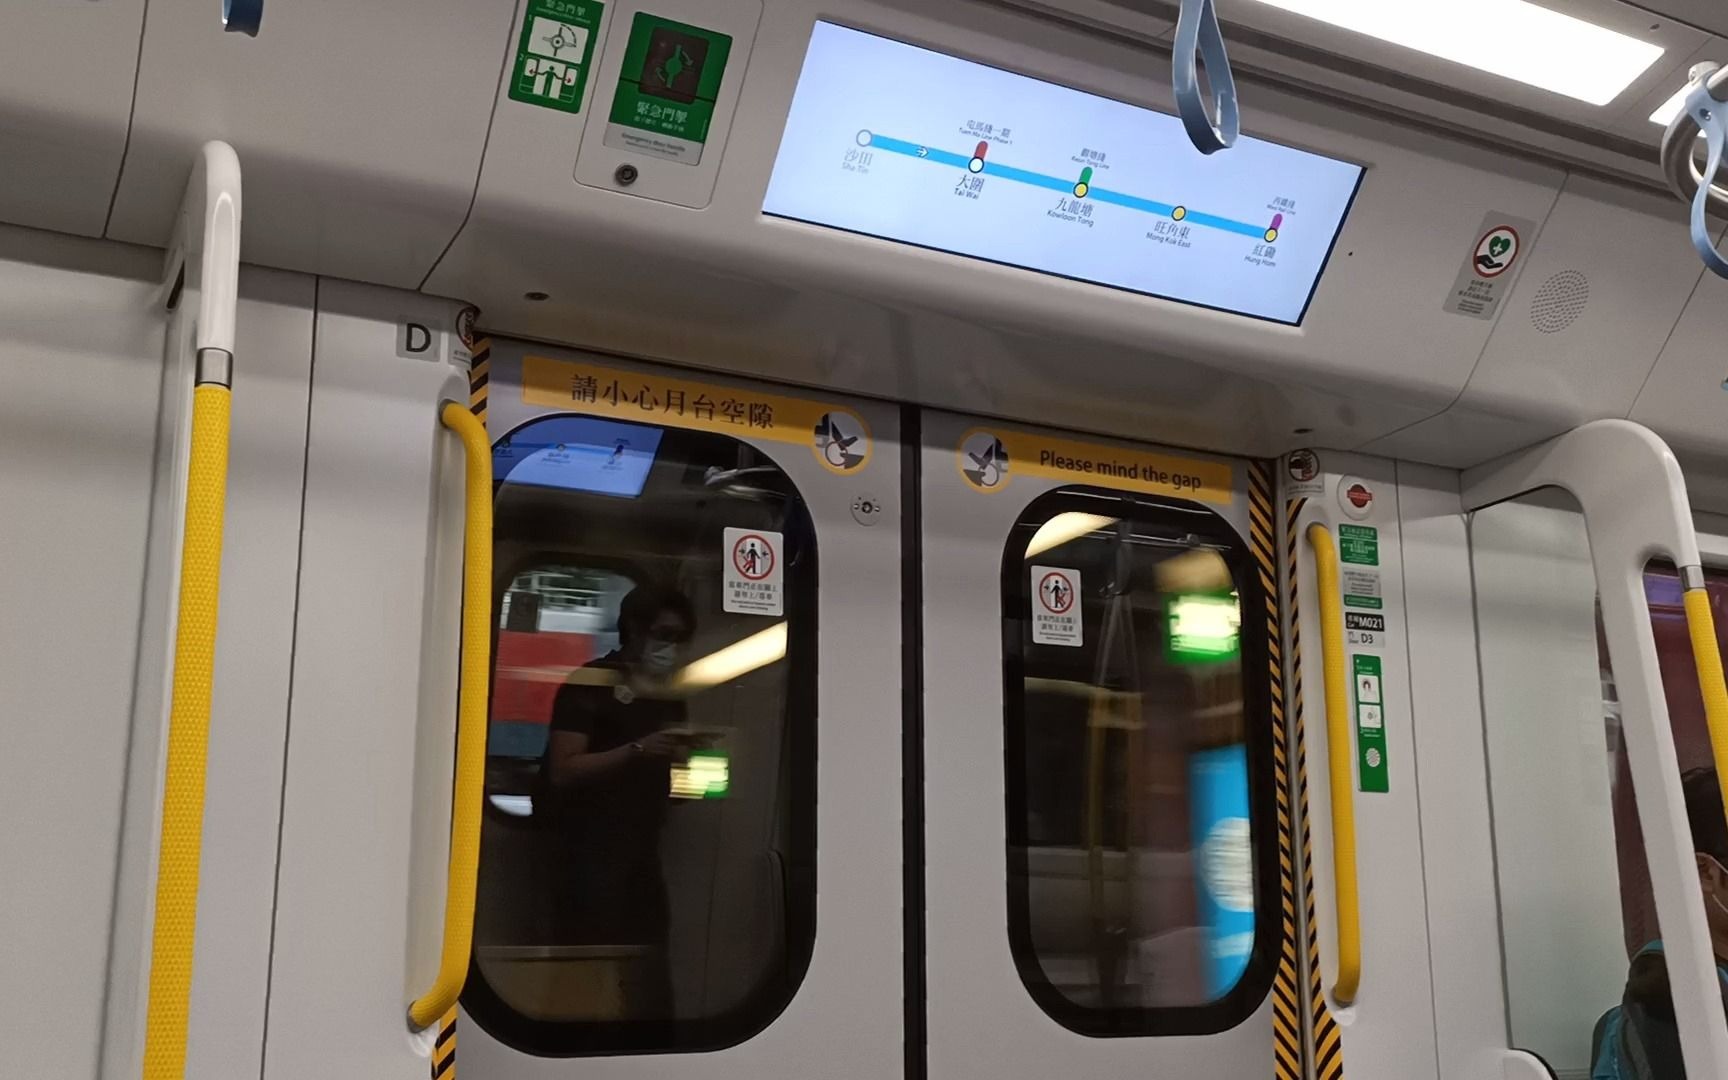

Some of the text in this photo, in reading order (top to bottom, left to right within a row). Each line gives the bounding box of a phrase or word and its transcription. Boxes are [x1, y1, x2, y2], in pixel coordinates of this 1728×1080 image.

[844, 148, 873, 166] 沙田
[842, 162, 869, 174] Sha Tin
[956, 174, 984, 192] 大圍
[954, 187, 979, 199] Tai Wai
[1055, 197, 1094, 218] 九龍塘
[1047, 209, 1094, 228] Kowloon Tong
[1154, 220, 1191, 240] 旺角東
[1146, 232, 1191, 248] Mong Kok East
[1244, 255, 1260, 266] Hung
[406, 322, 431, 352] D
[570, 373, 774, 429] 請小心月台空隙
[1040, 450, 1202, 492] Please mind the gap
[1359, 616, 1383, 629] M021
[1361, 633, 1374, 644] D3
